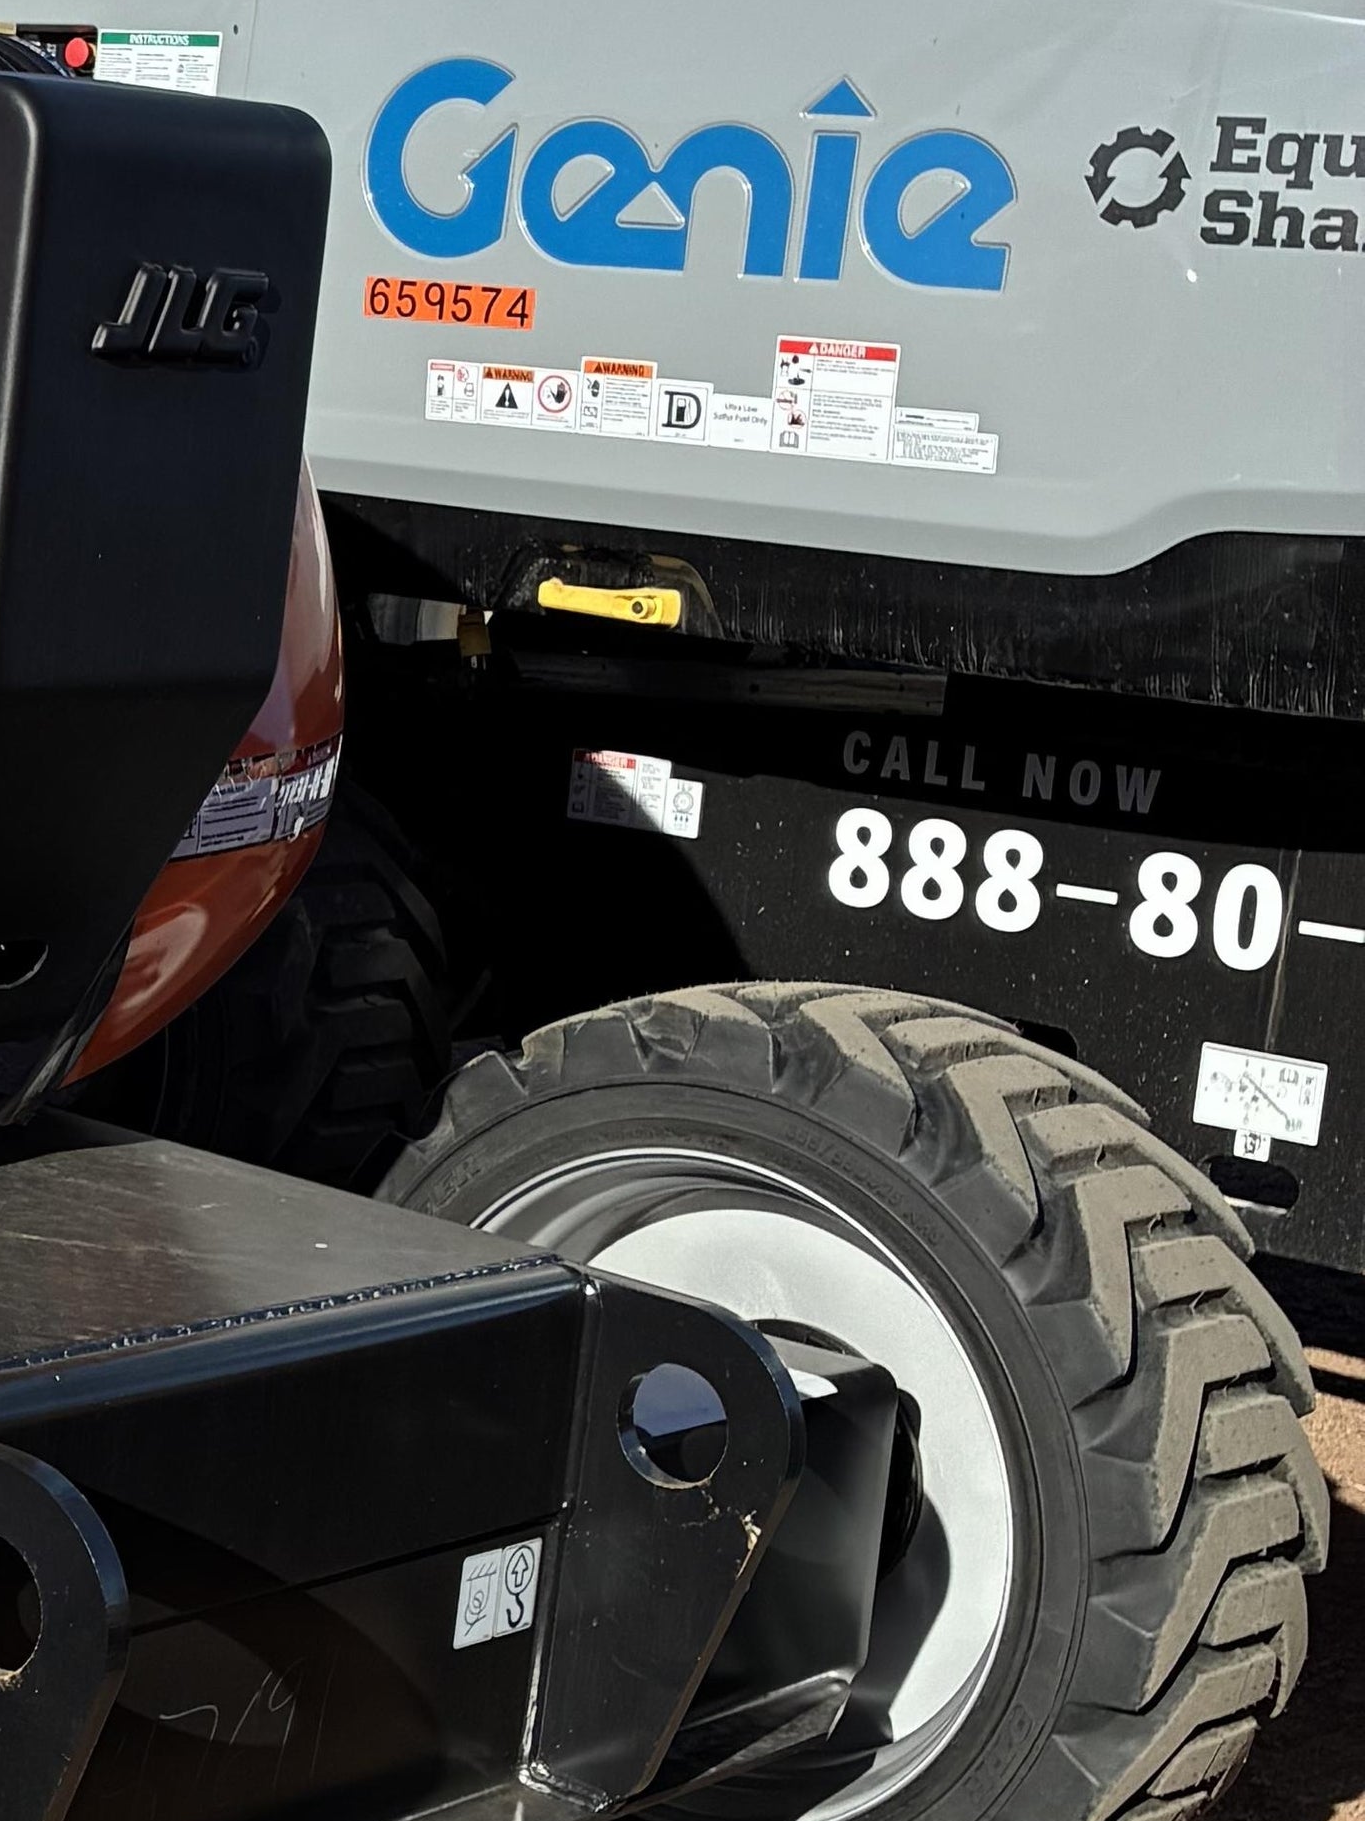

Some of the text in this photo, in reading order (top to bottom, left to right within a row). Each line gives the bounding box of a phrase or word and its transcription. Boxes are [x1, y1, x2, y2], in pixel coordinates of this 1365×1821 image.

[128, 33, 190, 47] INSTRUCTIONS
[363, 56, 1018, 294] Genie
[1200, 188, 1365, 252] Sha
[369, 277, 529, 328] 659574
[819, 343, 867, 358] DANGER
[493, 368, 534, 382] WARNING
[602, 361, 645, 378] WARNING
[842, 730, 1162, 815] CALL NOW
